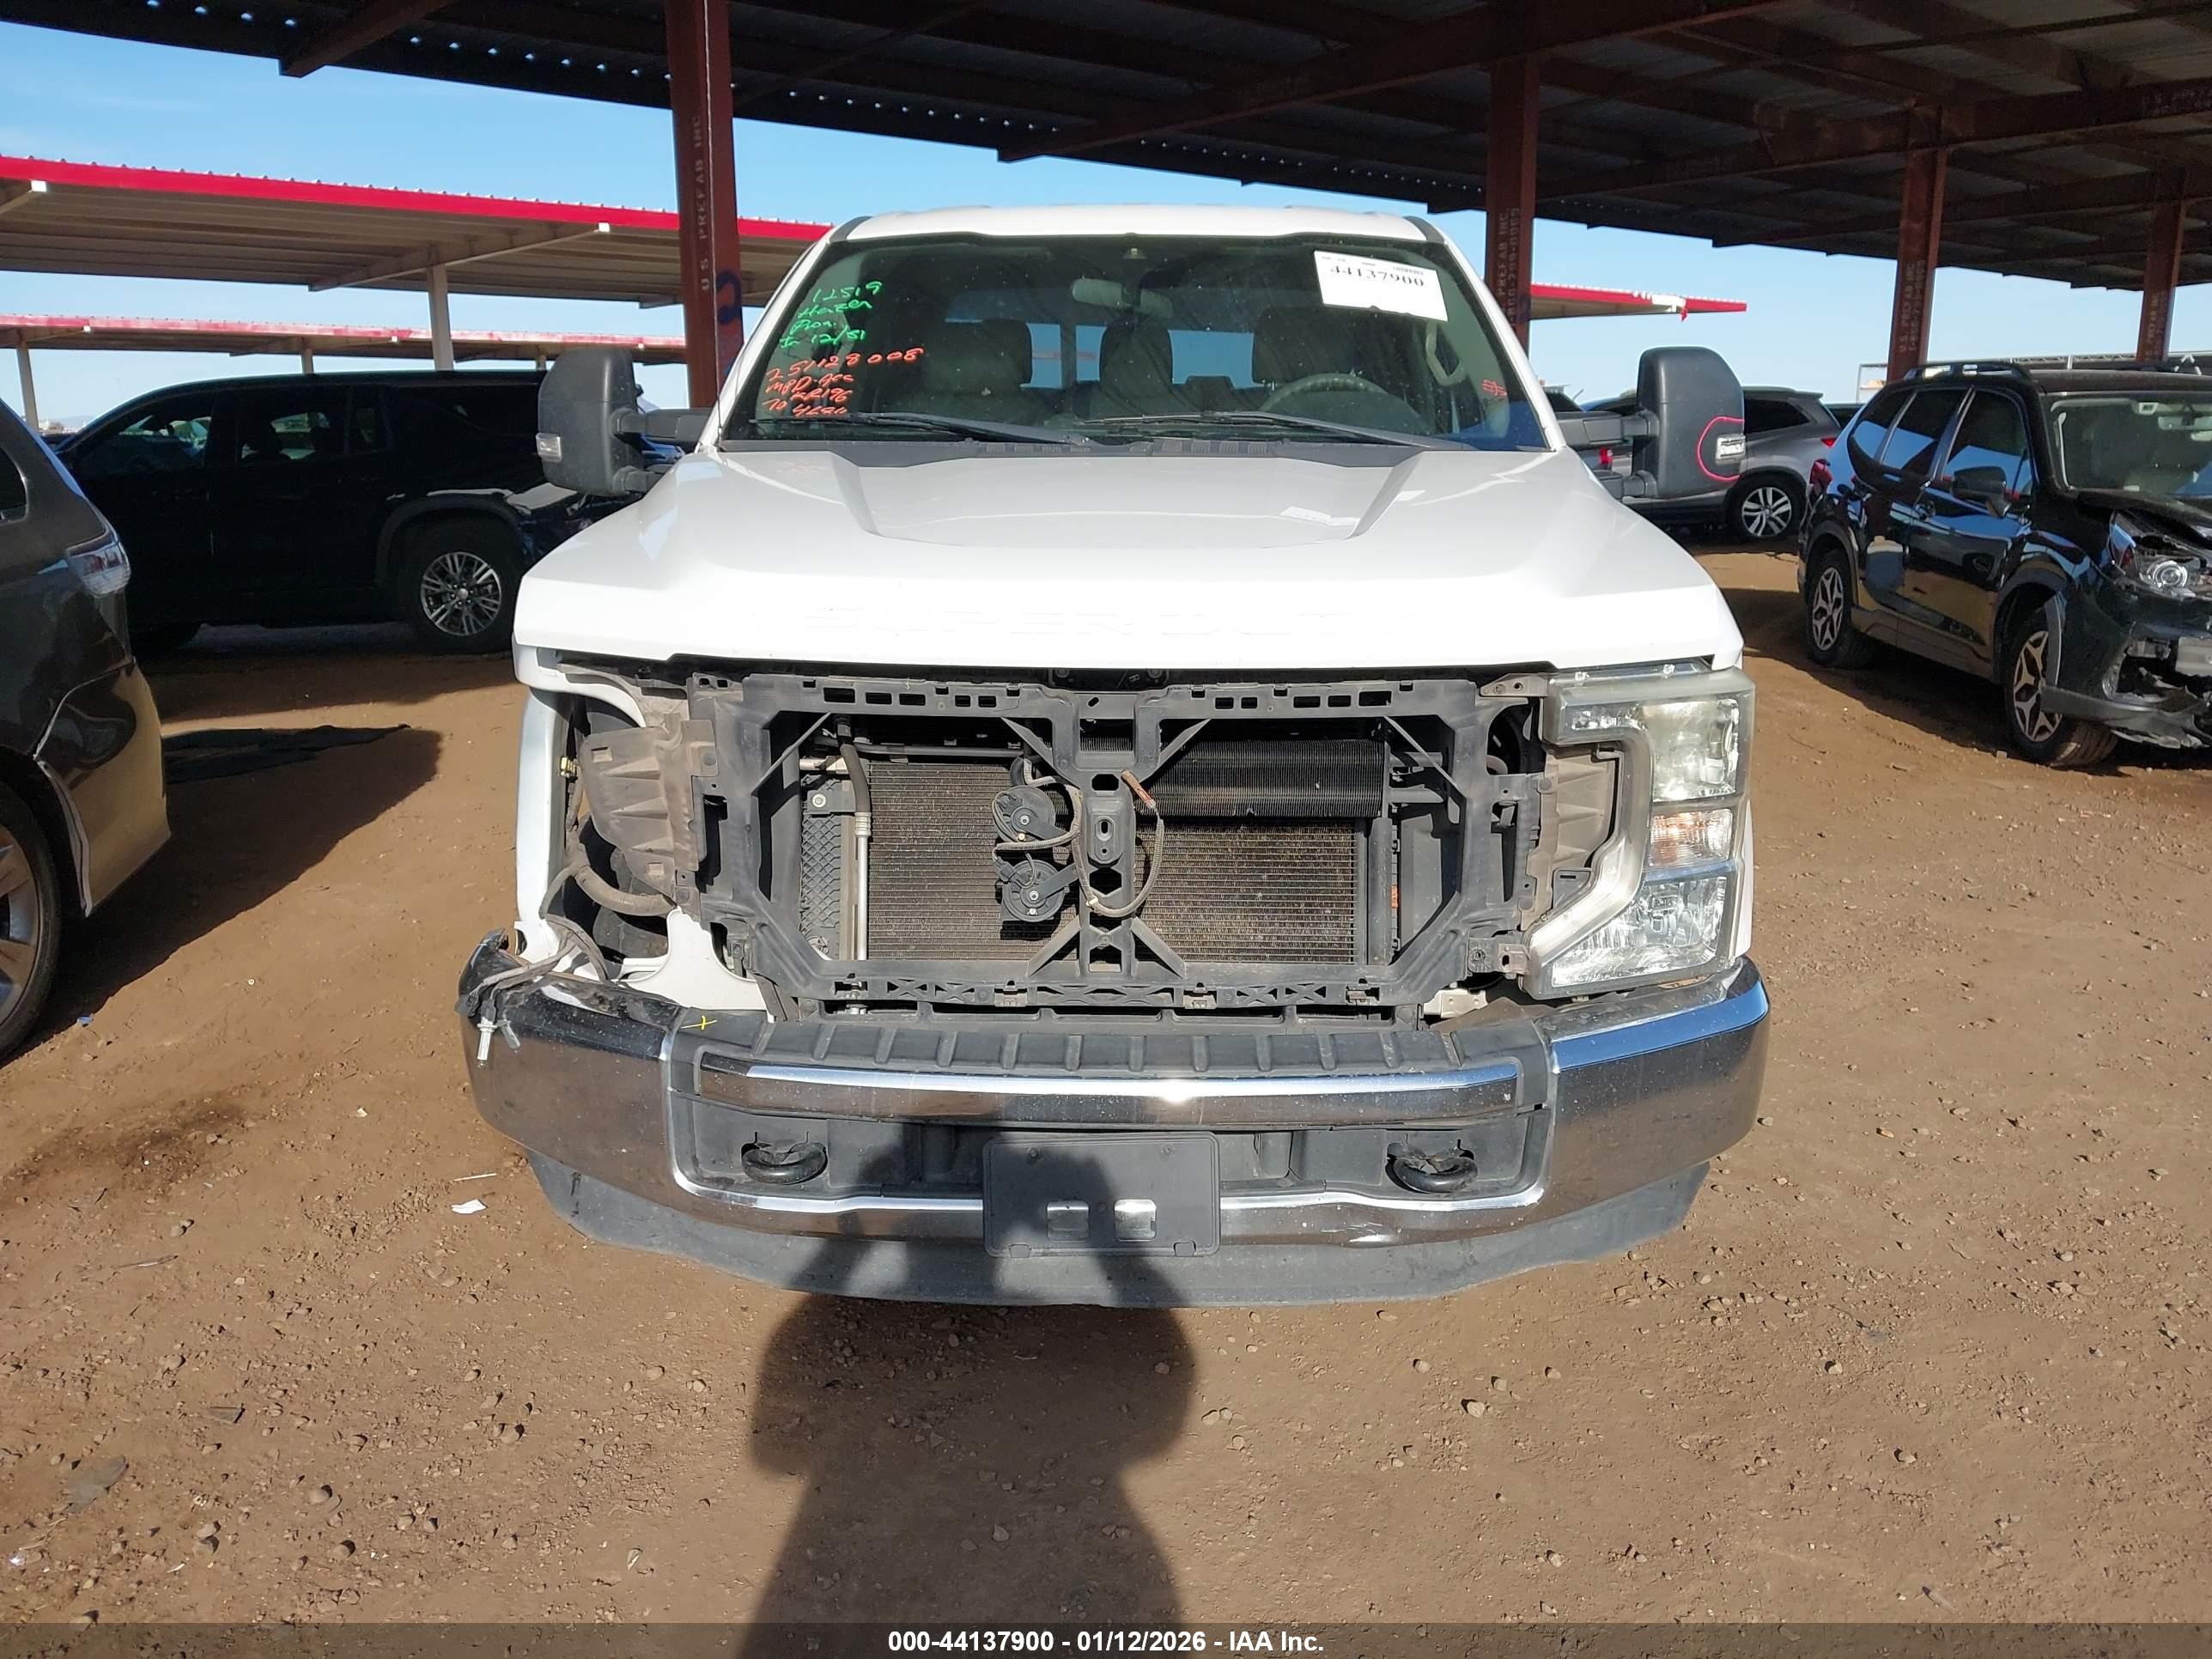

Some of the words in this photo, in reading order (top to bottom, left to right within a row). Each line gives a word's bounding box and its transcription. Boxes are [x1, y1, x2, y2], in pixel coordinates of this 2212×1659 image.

[694, 158, 708, 240] PREFAB
[1330, 265, 1425, 287] 44137900
[802, 602, 1133, 638] SUPER
